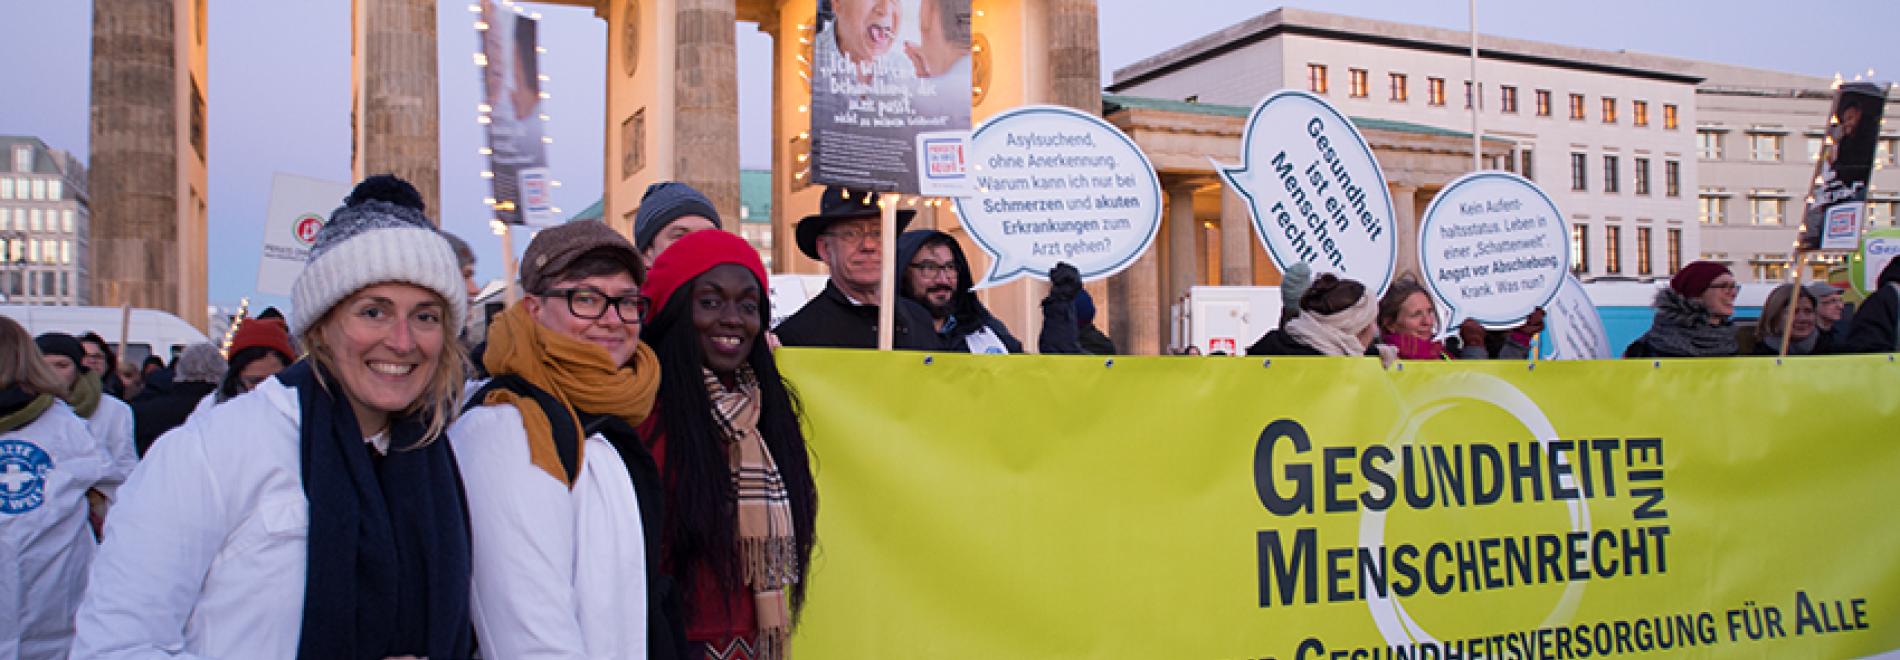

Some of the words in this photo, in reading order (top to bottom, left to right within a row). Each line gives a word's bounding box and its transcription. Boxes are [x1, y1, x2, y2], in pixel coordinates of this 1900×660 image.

[1006, 132, 1096, 149] Asylsuchend,
[988, 154, 1024, 168] ohne
[1027, 153, 1119, 170] Anerkennung.
[976, 175, 1029, 190] Warum
[1032, 174, 1066, 189] kann
[1069, 174, 1089, 187] ich
[1092, 175, 1112, 187] nur
[1115, 172, 1136, 188] bei
[1307, 117, 1382, 242] Gesundheit
[983, 197, 1064, 213] Schmerzen
[1066, 197, 1091, 211] und
[1095, 195, 1140, 209] akuten
[1305, 160, 1328, 195] ist
[1325, 196, 1349, 232] ein
[1271, 150, 1346, 272] Menschen-
[1459, 201, 1482, 216] Kein
[1486, 198, 1522, 213] Aufent-
[1002, 217, 1100, 236] Erkrankungen
[1102, 217, 1130, 231] zum
[1504, 217, 1535, 233] Leben
[1537, 215, 1547, 228] in
[1032, 240, 1060, 256] Arzt
[1063, 238, 1111, 257] gehen?
[1443, 244, 1470, 260] einer
[1439, 265, 1471, 283] Angst
[1473, 264, 1489, 277] vor
[1497, 280, 1519, 294] Was
[1253, 418, 1620, 516] GESUNDHEIT
[1625, 438, 1668, 519] EIN
[1256, 527, 1670, 608] MENSCHENRECHT
[1296, 612, 1718, 660] DHEITSVERSORGUNG
[1727, 601, 1786, 642] FÜR
[1795, 591, 1869, 635] ALLE
